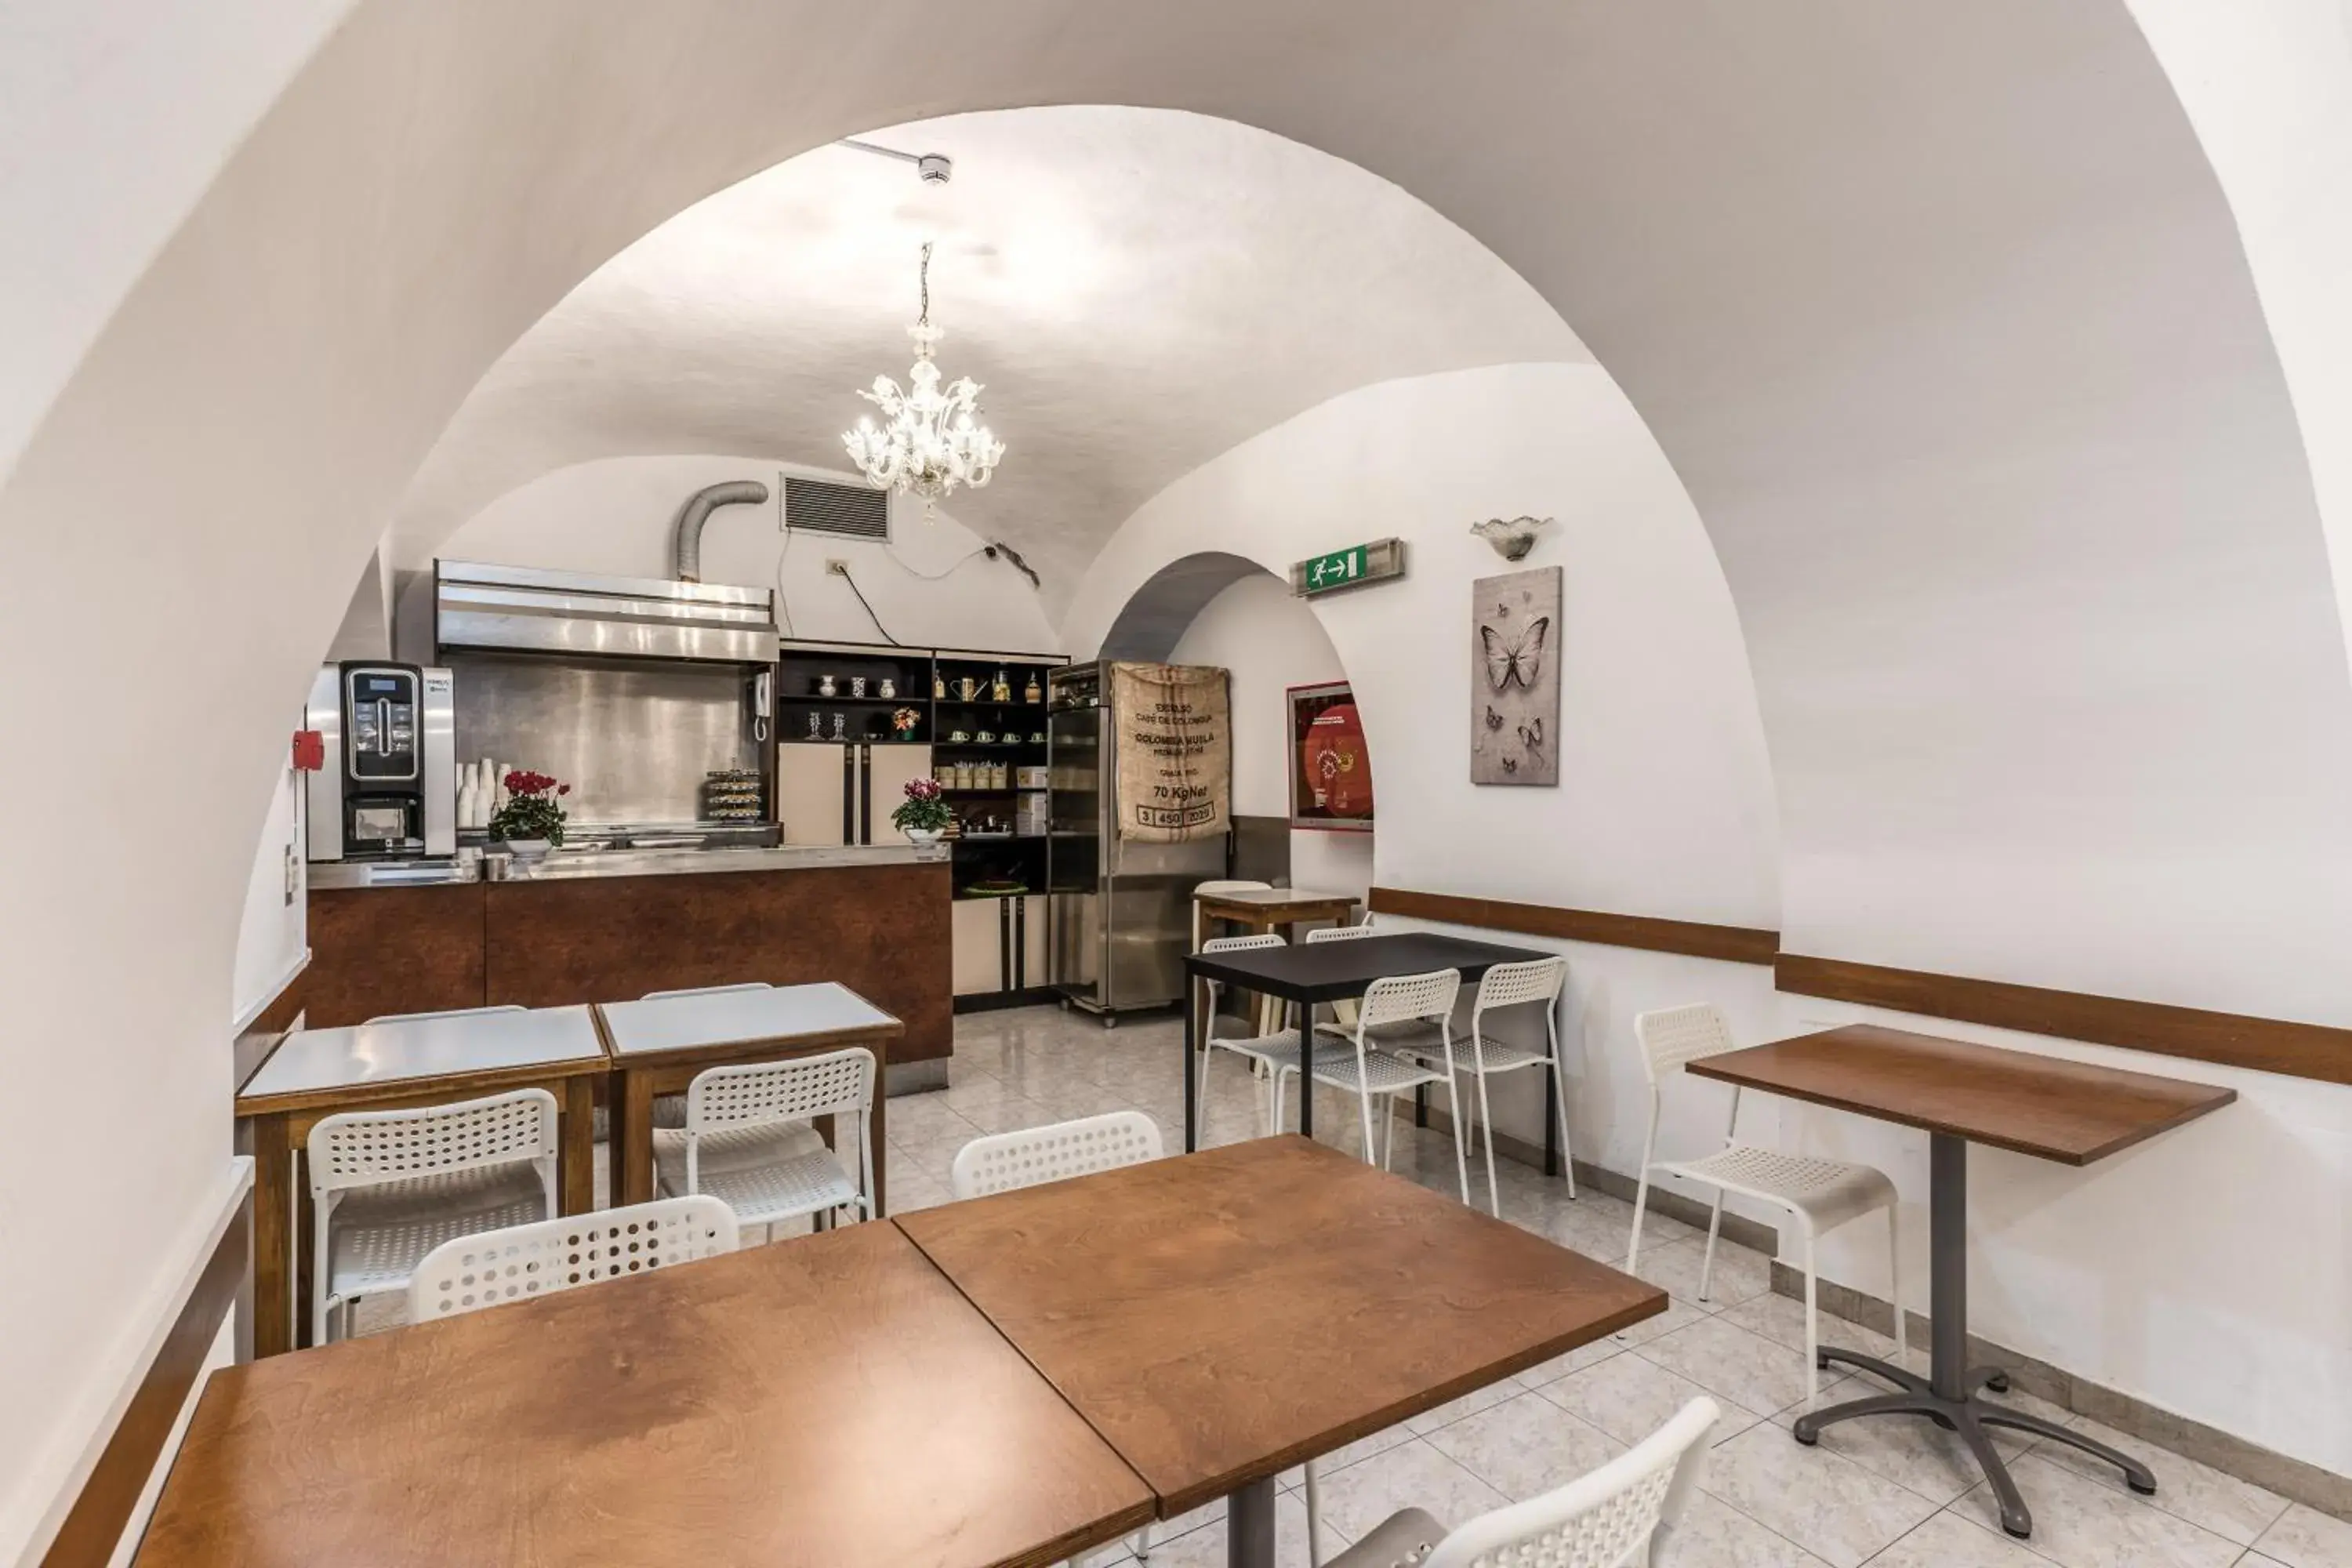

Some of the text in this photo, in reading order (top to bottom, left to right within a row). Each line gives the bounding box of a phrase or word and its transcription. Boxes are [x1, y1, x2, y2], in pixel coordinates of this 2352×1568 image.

[1153, 786, 1168, 798] 70
[1142, 811, 1149, 822] 3
[1159, 813, 1181, 824] 450
